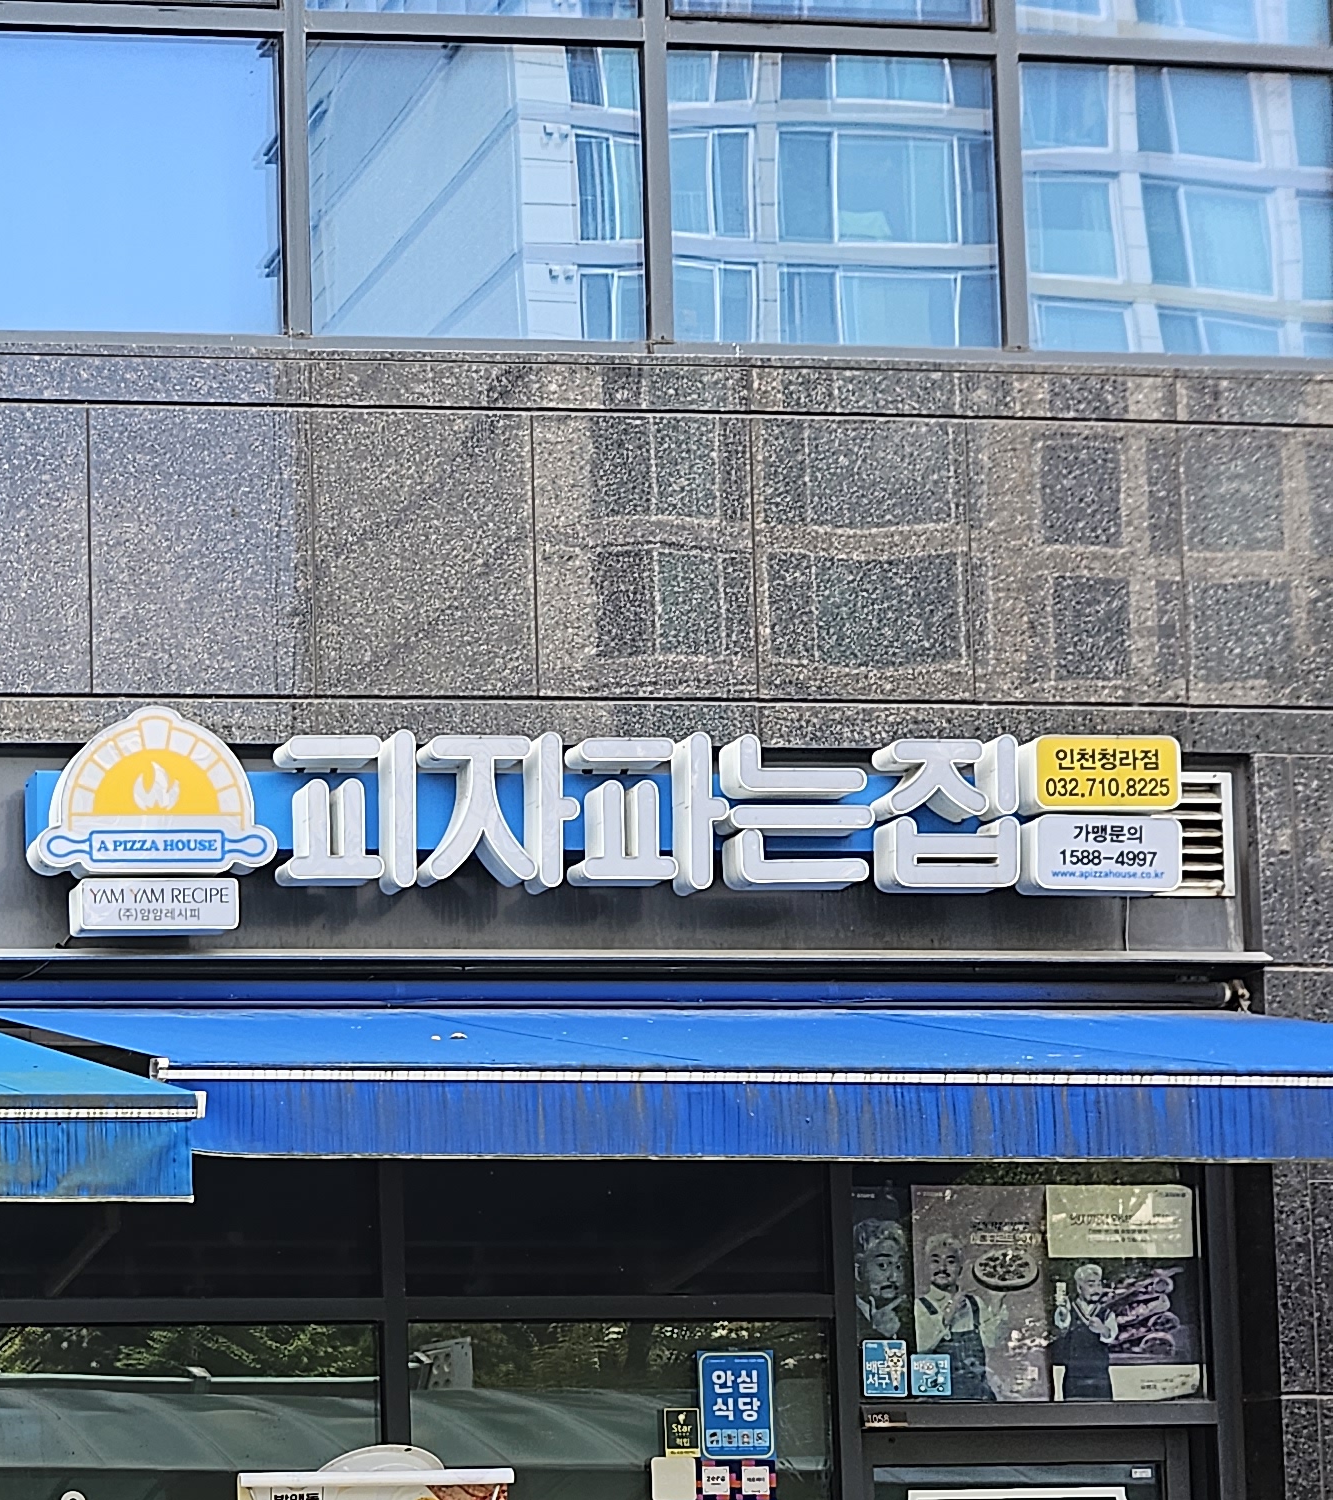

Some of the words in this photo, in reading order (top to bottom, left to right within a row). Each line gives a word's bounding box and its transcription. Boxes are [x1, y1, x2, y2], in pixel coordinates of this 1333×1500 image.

[1055, 746, 1161, 772] 인천청라점
[1045, 774, 1171, 800] 032.710.8225
[273, 729, 1023, 896] 피자파는집
[1072, 823, 1144, 845] 가맹문의
[97, 839, 111, 852] A
[112, 838, 161, 853] PIZZA
[164, 838, 218, 852] HOUSE
[1058, 848, 1158, 869] 1588-4997
[90, 887, 126, 904] YAM
[129, 887, 168, 904] YAM
[171, 887, 230, 904] RECIPE
[117, 907, 201, 922] (주)얌얌레시피
[711, 1369, 759, 1394] 안심
[713, 1396, 762, 1422] 식당
[868, 1414, 889, 1423] 1058
[671, 1423, 692, 1433] Star
